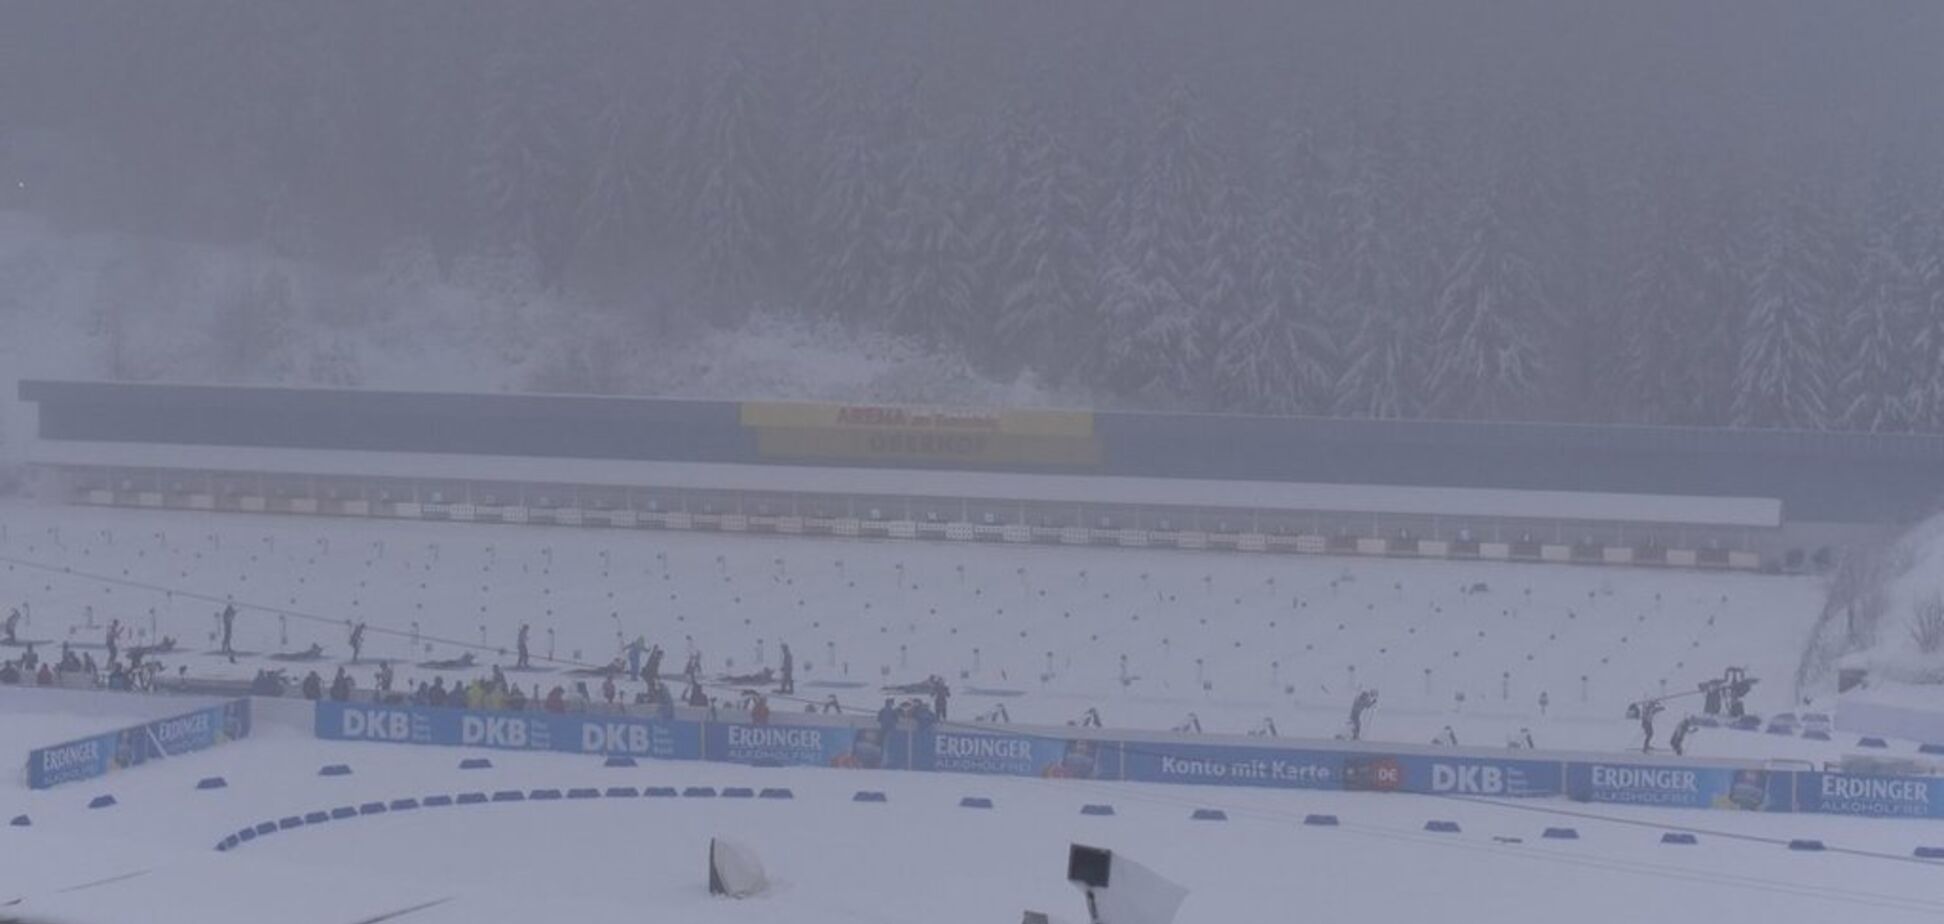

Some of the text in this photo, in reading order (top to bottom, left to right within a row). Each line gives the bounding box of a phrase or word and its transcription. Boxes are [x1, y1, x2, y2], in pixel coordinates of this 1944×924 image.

[343, 708, 409, 739] DKB
[461, 714, 527, 747] DKB
[582, 721, 649, 753] DKB
[727, 725, 823, 750] ERDINGER
[935, 734, 1032, 761] ERDINGER
[1161, 755, 1226, 776] Konto
[1231, 759, 1266, 778] mit
[1271, 760, 1331, 782] Karte
[1432, 763, 1504, 793] DKB
[1591, 765, 1699, 792] ERDINGER
[1821, 774, 1929, 803] ERDINGER
